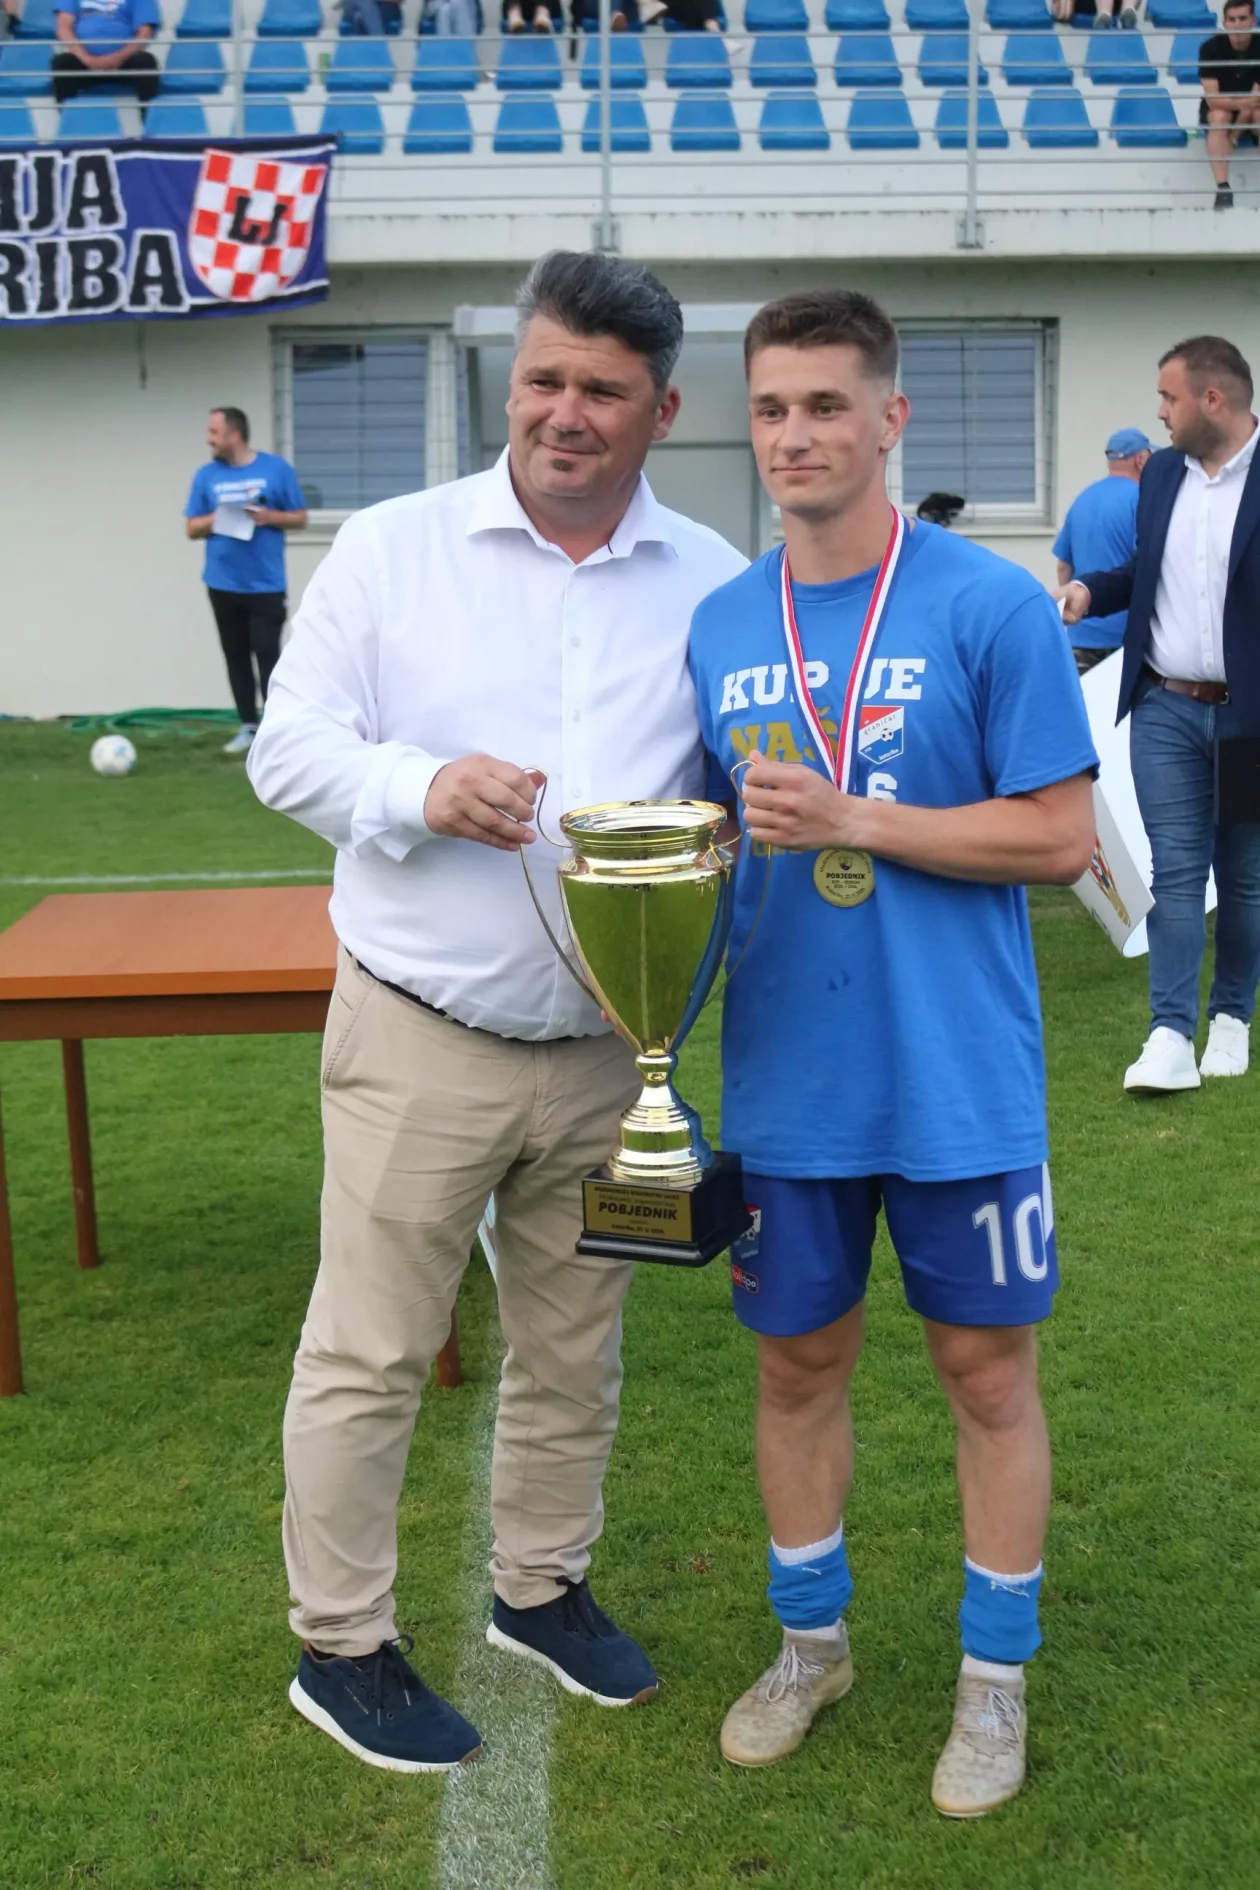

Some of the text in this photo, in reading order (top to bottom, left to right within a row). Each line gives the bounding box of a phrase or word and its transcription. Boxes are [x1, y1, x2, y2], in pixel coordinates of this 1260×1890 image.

[0, 231, 188, 317] RIBA
[719, 658, 927, 714] KUP JE
[598, 1202, 678, 1220] POBJEDNIK
[971, 1193, 1048, 1286] 10
